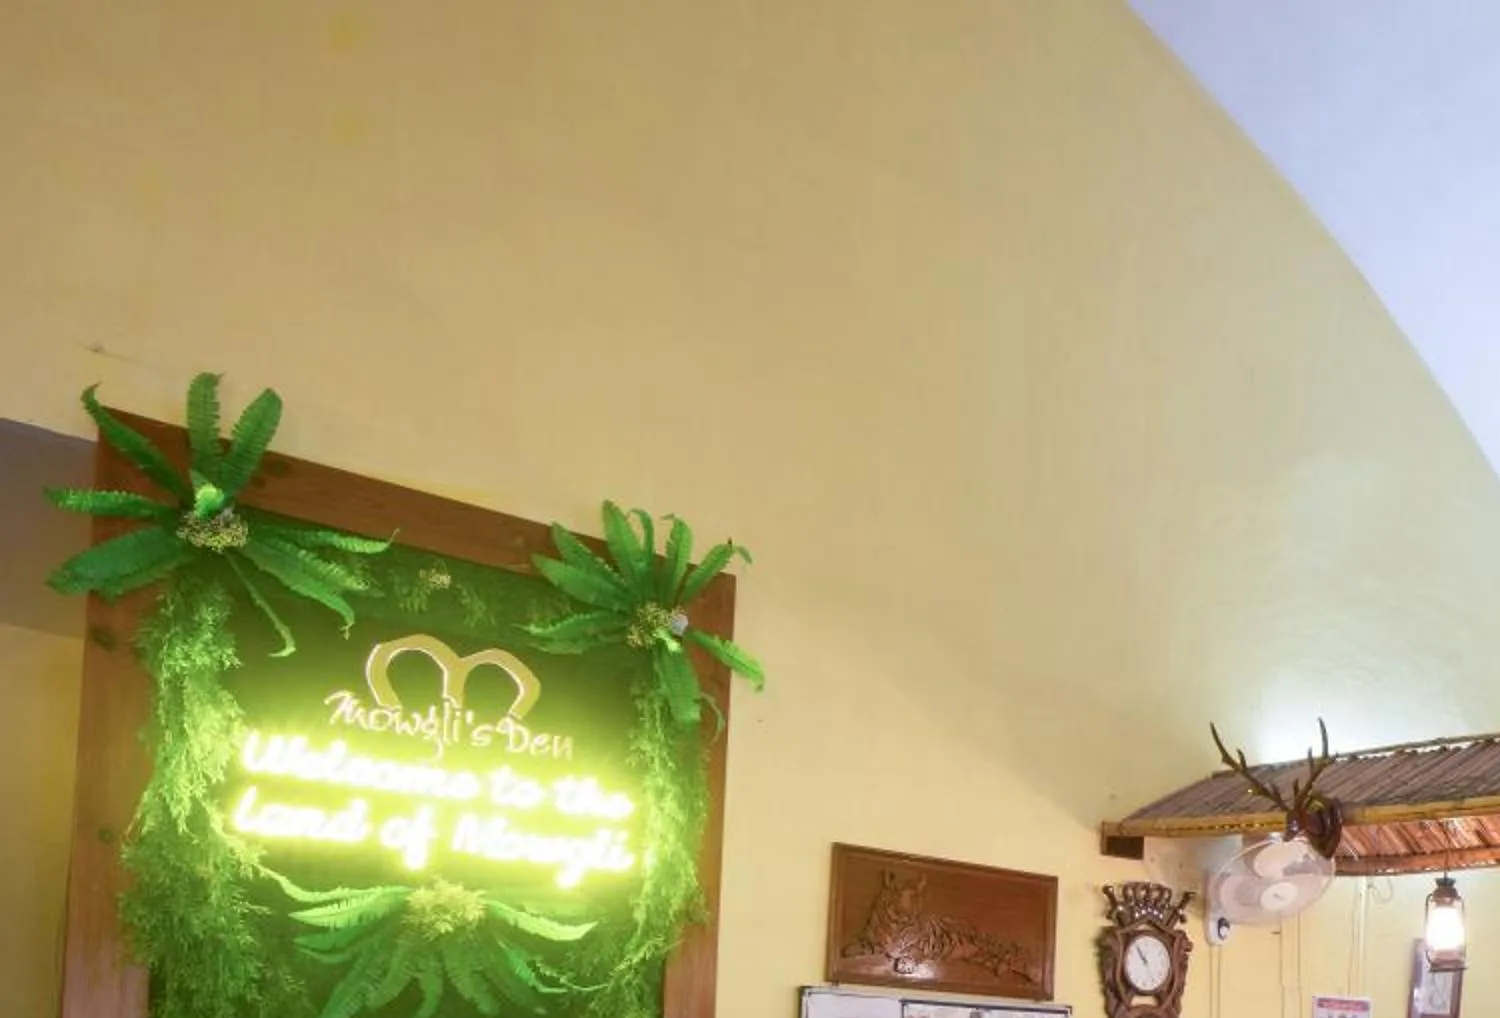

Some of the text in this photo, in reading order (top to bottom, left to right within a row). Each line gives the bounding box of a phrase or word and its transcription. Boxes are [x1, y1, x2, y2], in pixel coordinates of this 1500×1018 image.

[243, 729, 635, 819] Welcome to the
[496, 717, 574, 759] Den
[233, 785, 635, 890] Land of Mowgli
